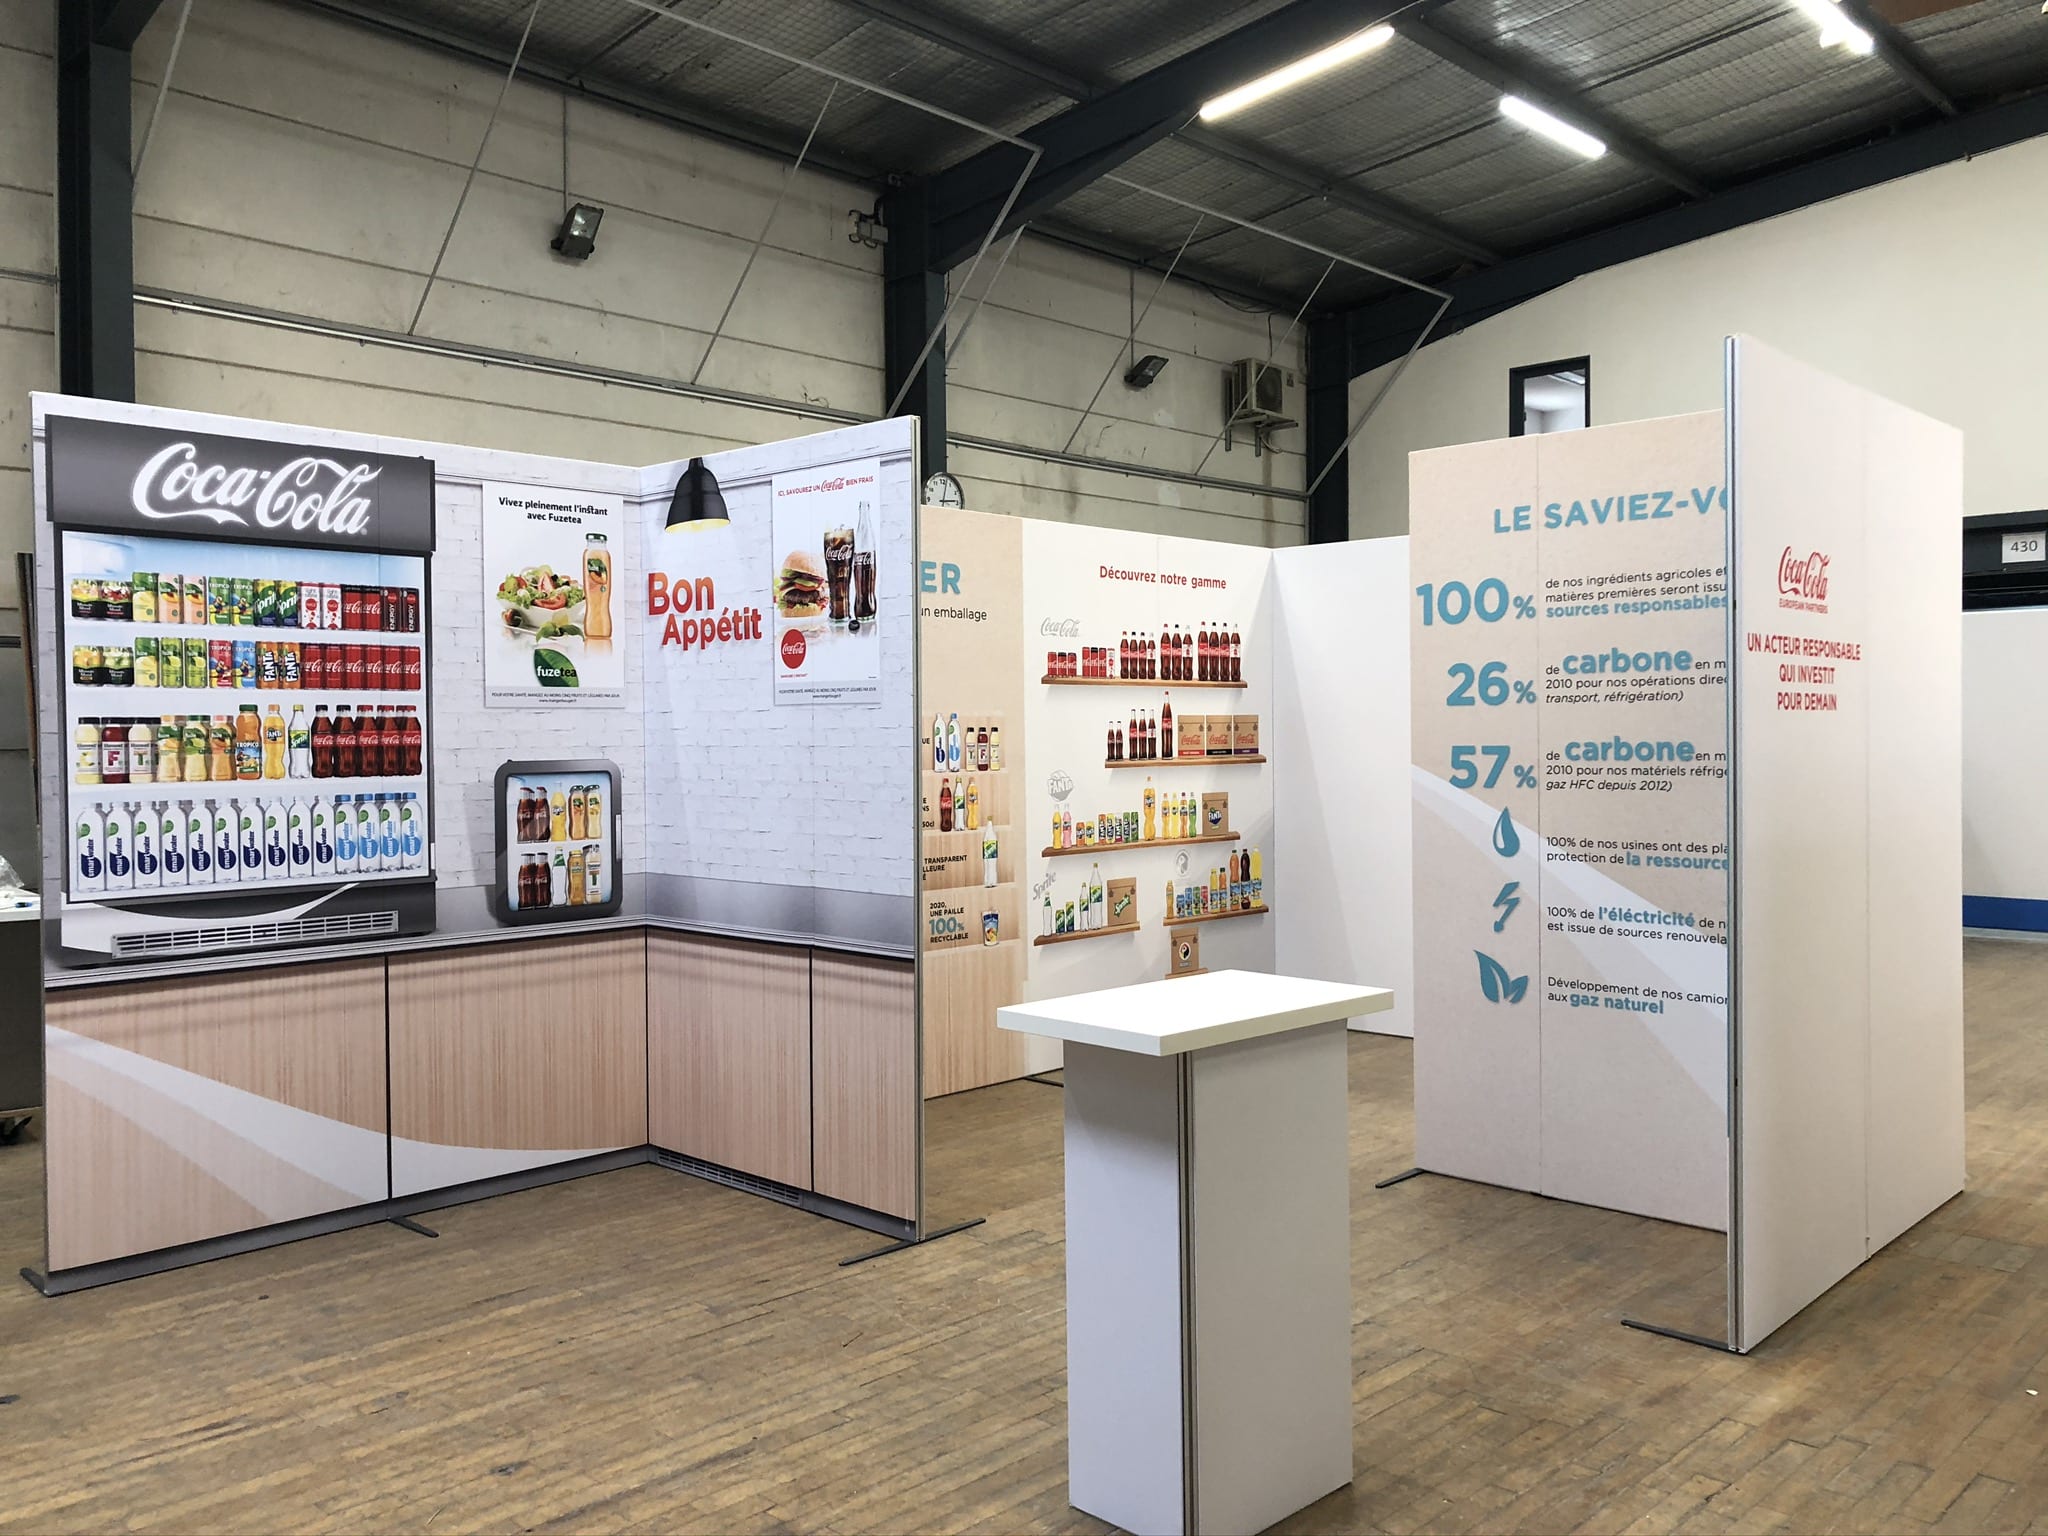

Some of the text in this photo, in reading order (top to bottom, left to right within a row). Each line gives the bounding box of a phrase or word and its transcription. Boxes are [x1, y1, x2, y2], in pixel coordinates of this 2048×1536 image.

[132, 441, 383, 535] Coca-Cola
[786, 486, 812, 496] SAVOUREZ
[821, 477, 844, 492] Coca-Cola
[846, 478, 858, 486] BIEN
[858, 476, 874, 484] FRAIS
[499, 497, 523, 508] Vivez
[525, 500, 572, 514] pleinement
[527, 512, 582, 524] avec Fuzetea
[1494, 505, 1531, 534] LE
[2010, 540, 2038, 553] 430
[920, 561, 961, 595] ER
[1100, 565, 1227, 590] Découvrez notre gamme
[1546, 578, 1560, 589] de
[1563, 577, 1583, 588] nos
[1586, 571, 1652, 588] ingrédients
[1656, 567, 1712, 583] agricoles
[1778, 545, 1830, 601] Coca-Cola
[648, 572, 715, 616] Bon
[1546, 589, 1594, 603] matières
[1598, 586, 1656, 601] premières
[1660, 583, 1700, 595] seront
[934, 606, 987, 622] emballage
[1546, 602, 1609, 619] sources
[662, 607, 762, 650] Appétit
[1040, 617, 1080, 638] Coca-Cola
[1748, 632, 1860, 661] UN ACTEUR RESPONSABLE
[1546, 664, 1560, 675] de
[1562, 647, 1693, 675] carbone
[1695, 661, 1710, 670] en
[537, 666, 577, 678] fuzetea
[1779, 664, 1835, 684] QUI INVESTIT
[1546, 678, 1573, 689] 2010
[1576, 679, 1603, 692] pour
[1606, 678, 1628, 688] nos
[1630, 674, 1696, 690] opérations
[1546, 690, 1685, 705] transport, réfrigération)
[1777, 692, 1837, 711] POUR DEMAIN
[1546, 750, 1560, 761] de
[1564, 736, 1695, 762] carbone
[1695, 752, 1711, 761] en
[1546, 765, 1573, 776] 2010
[1576, 766, 1604, 778] pour
[1606, 766, 1628, 776] nos
[1630, 763, 1686, 777] matériels
[1048, 777, 1073, 794] FANTA
[1546, 780, 1674, 792] gaz HFC depuis 2012)
[1547, 837, 1576, 848] 100%
[1580, 838, 1594, 848] de
[1597, 840, 1618, 850] nos
[1622, 839, 1658, 851] usines
[1662, 842, 1682, 852] ont
[1686, 842, 1711, 853] des
[924, 855, 967, 864] TRANSPARENT
[1547, 852, 1606, 865] protection
[1609, 854, 1624, 864] de
[1626, 853, 1641, 866] la
[1033, 872, 1056, 900] Sprite
[930, 902, 947, 910] 2020,
[930, 908, 964, 918] UNE PAILLE
[1547, 906, 1577, 919] 100%
[1580, 909, 1595, 920] de
[1599, 906, 1695, 928] l'éléctricité
[1699, 918, 1714, 928] de
[930, 933, 968, 944] RECYCLABLE
[1548, 922, 1564, 932] est
[1567, 922, 1595, 934] issue
[1598, 924, 1614, 935] de
[1617, 928, 1662, 940] sources
[1548, 977, 1639, 997] Développement
[1643, 986, 1658, 998] de
[1662, 989, 1683, 1000] nos
[1548, 992, 1664, 1014] aux gaz naturel
